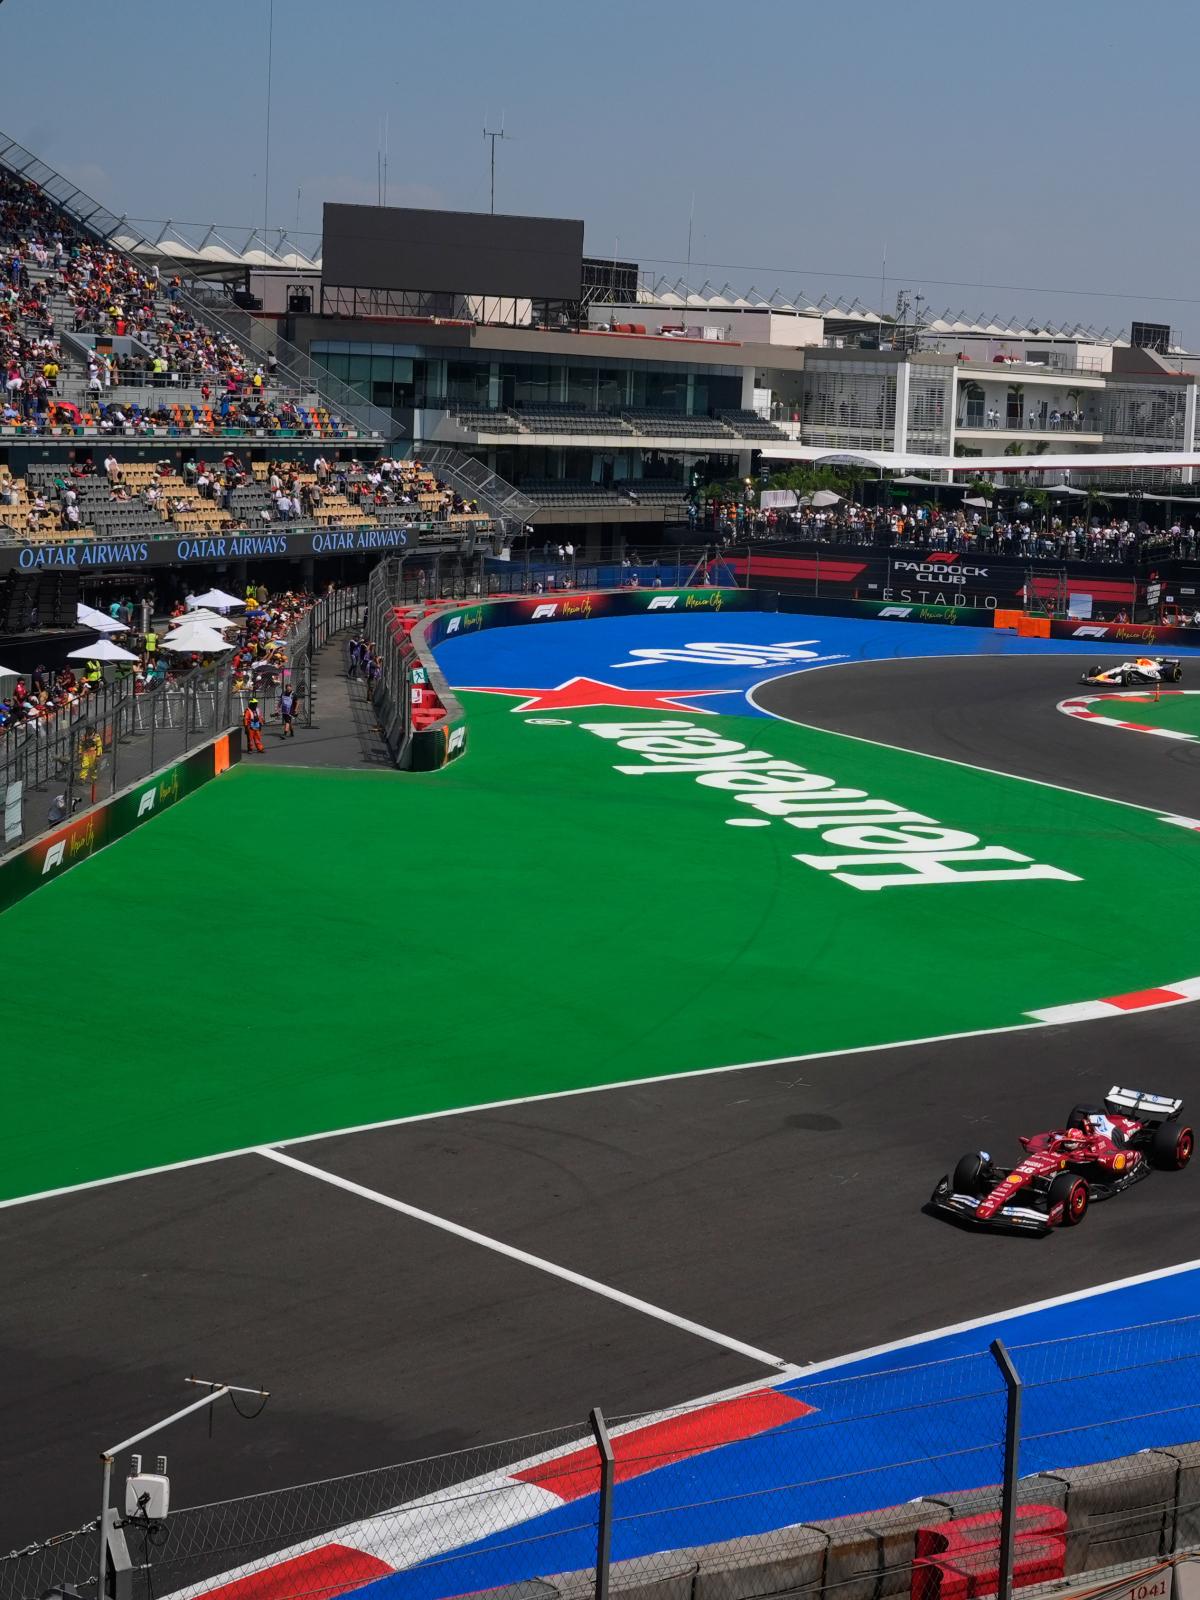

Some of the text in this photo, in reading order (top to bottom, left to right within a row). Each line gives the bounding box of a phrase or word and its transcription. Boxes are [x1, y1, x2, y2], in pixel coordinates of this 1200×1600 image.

[177, 536, 287, 560] QATAR AIRWAYS
[312, 530, 407, 552] QATAR AIRWAYS
[20, 543, 148, 569] QATAR AIRWAYS
[894, 561, 989, 577] PADDOCK
[916, 573, 967, 584] CLUB
[883, 588, 998, 609] ESTADIO
[579, 720, 1085, 891] Heineken
[1129, 1579, 1166, 1600] 1041
